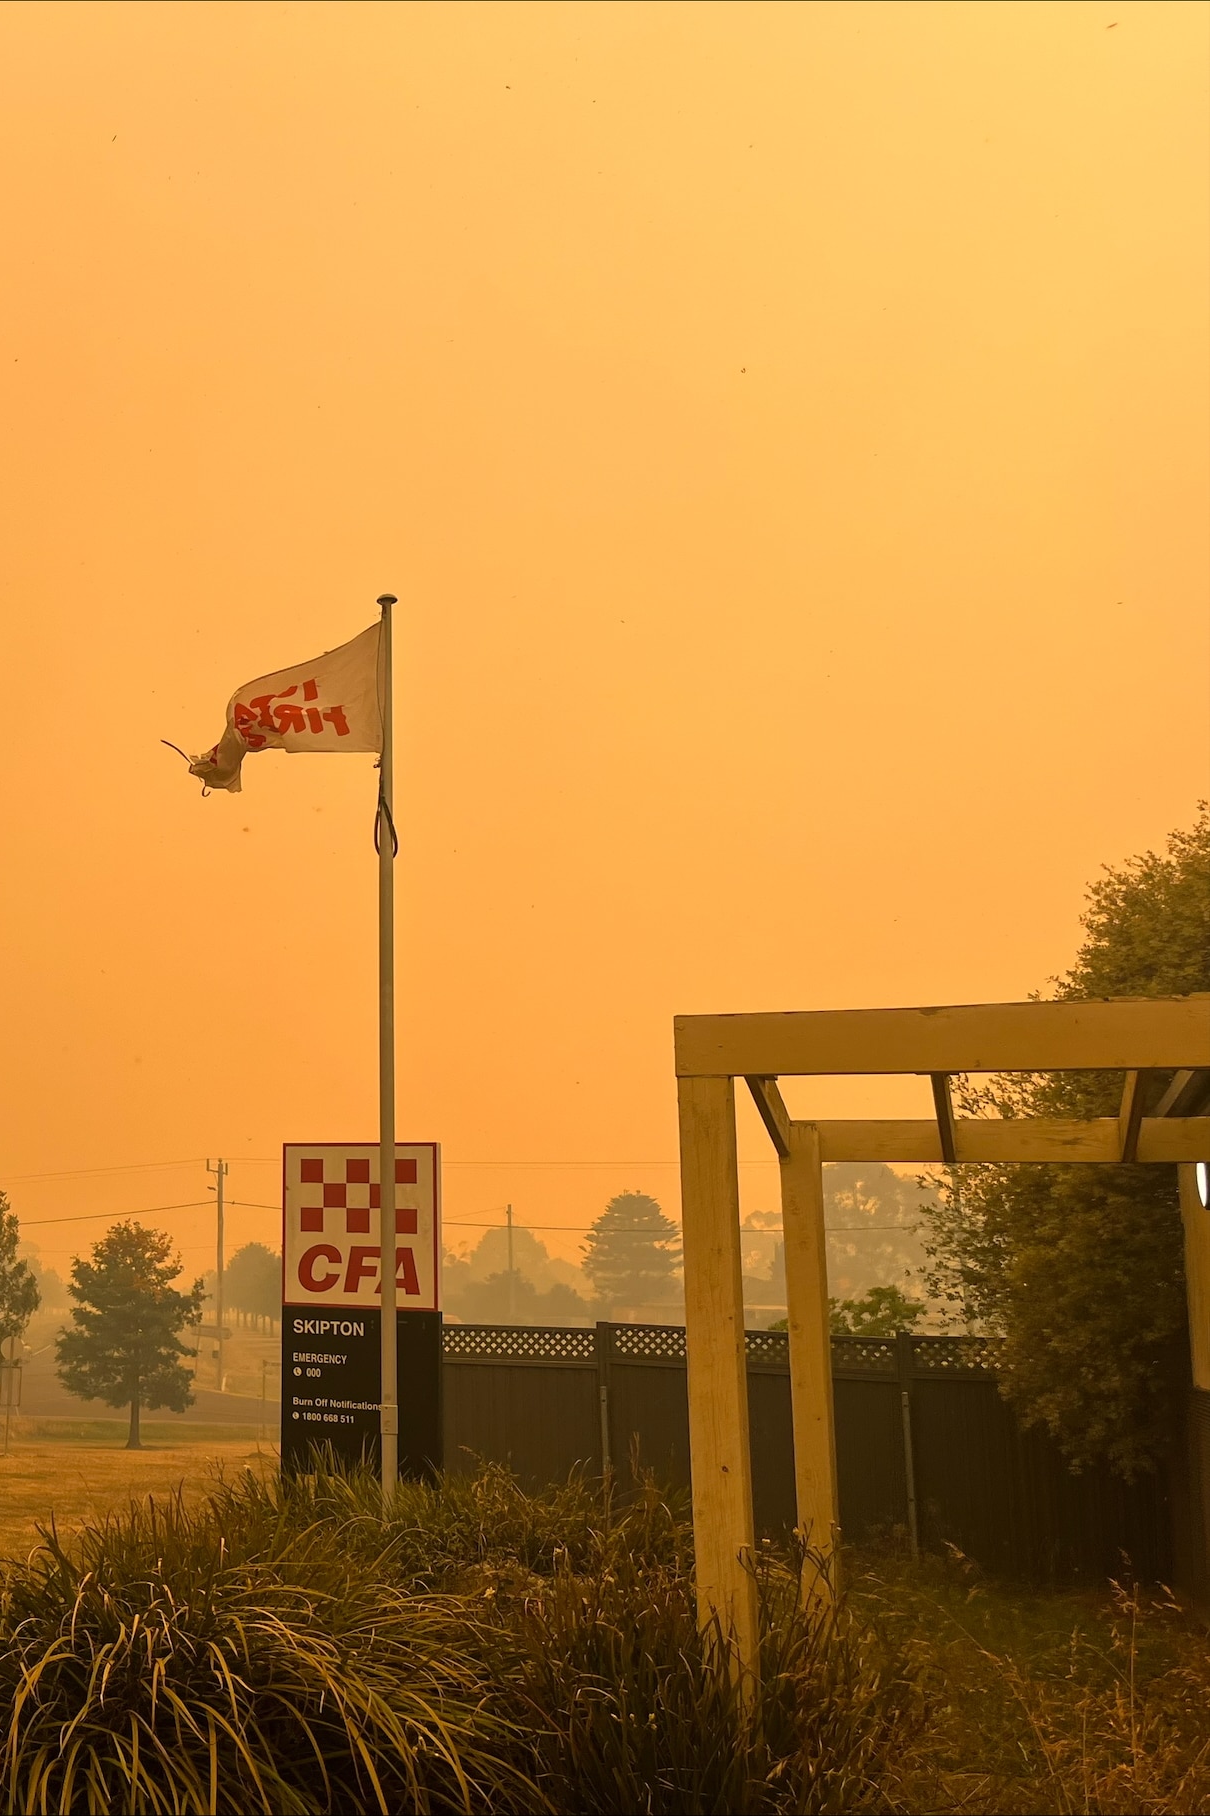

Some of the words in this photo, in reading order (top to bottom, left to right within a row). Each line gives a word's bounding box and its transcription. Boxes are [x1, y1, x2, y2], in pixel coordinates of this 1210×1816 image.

[298, 1244, 421, 1295] CFA
[293, 1319, 364, 1336] SKIPTON
[293, 1352, 347, 1364] EMERGENCY
[306, 1367, 321, 1377] 000
[293, 1397, 313, 1406] Burn
[315, 1398, 328, 1407] Off
[302, 1412, 321, 1421] 1800
[323, 1414, 338, 1422] 668
